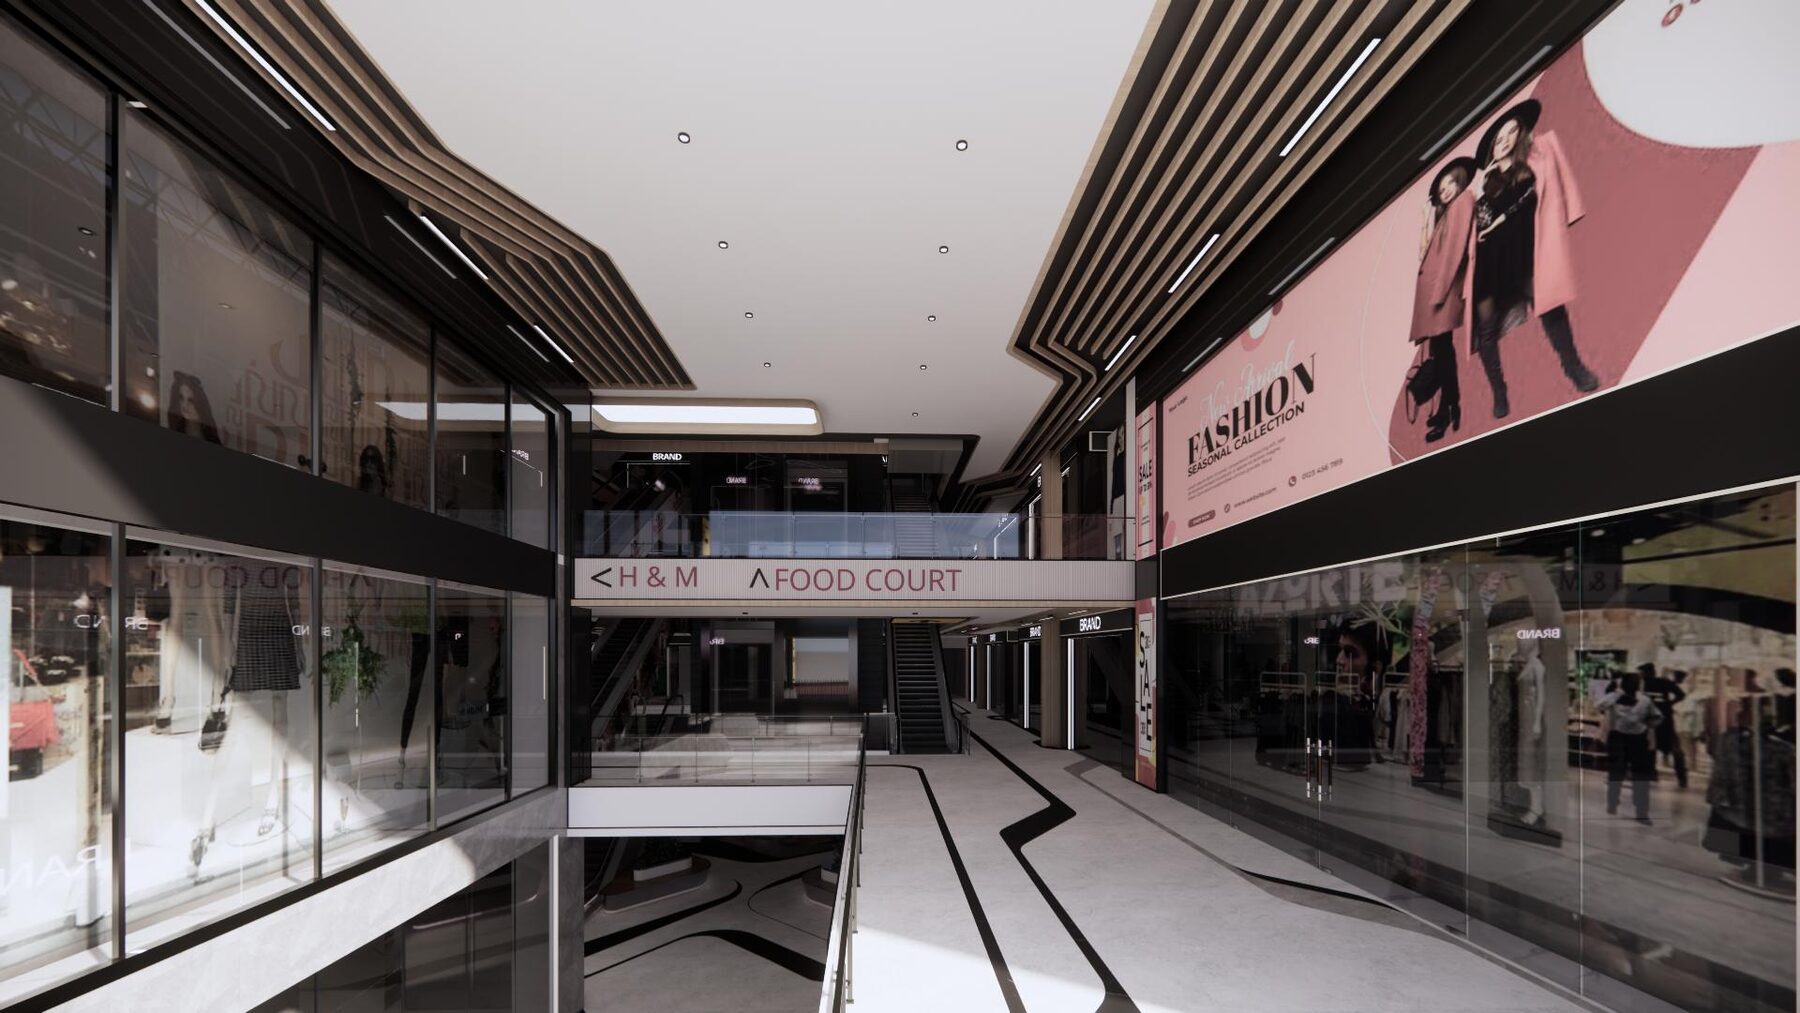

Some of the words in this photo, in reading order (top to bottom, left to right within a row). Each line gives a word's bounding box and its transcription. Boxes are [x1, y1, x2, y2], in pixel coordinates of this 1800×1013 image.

[1187, 352, 1317, 466] FASHION
[1187, 445, 1232, 478] SEASONAL
[1233, 400, 1306, 452] CALLECTION
[652, 453, 682, 461] BRAND
[1139, 460, 1153, 483] SALE
[619, 566, 637, 588] H
[647, 566, 665, 588] &
[676, 566, 698, 588] M
[775, 568, 856, 592] FOOD
[865, 568, 962, 592] COURT
[1080, 616, 1102, 632] BRAND
